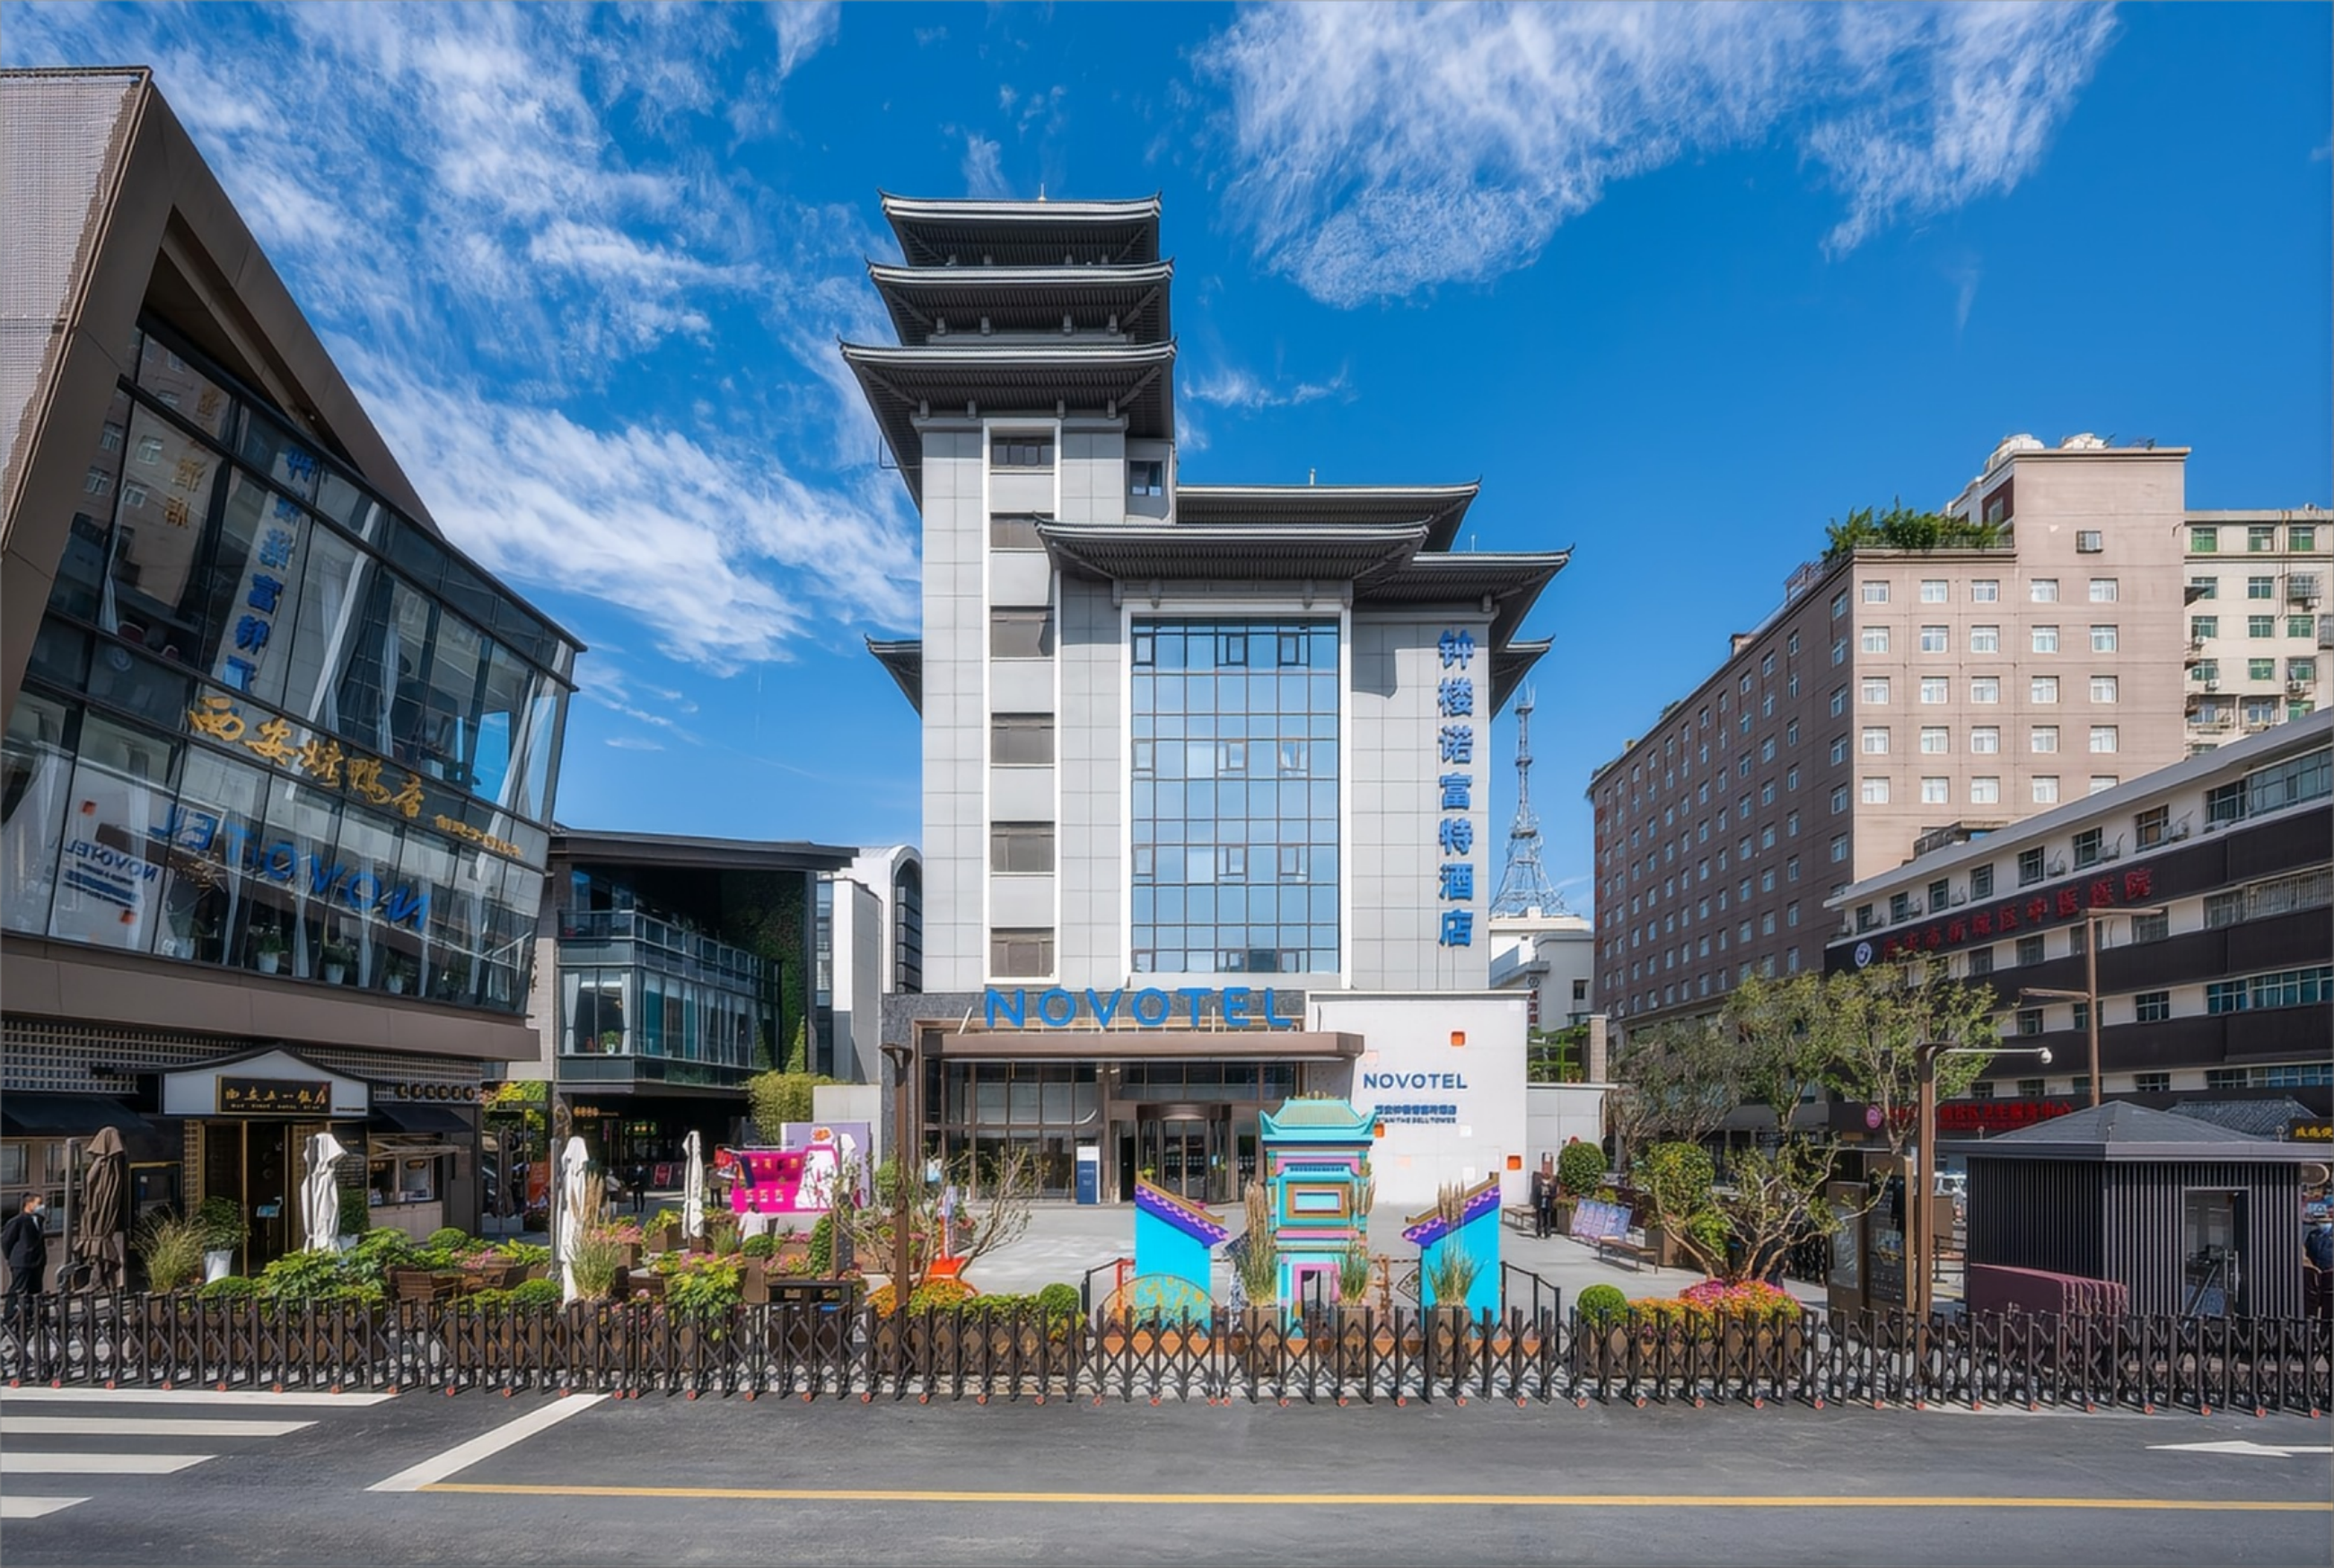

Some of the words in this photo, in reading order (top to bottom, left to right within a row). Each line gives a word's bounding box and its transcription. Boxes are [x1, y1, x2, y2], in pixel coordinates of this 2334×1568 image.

[189, 696, 426, 819] 西安烤鸭店
[1438, 630, 1474, 947] 钟楼诺富特酒店
[985, 987, 1294, 1029] NOVOTEL
[1363, 1073, 1468, 1090] NOVOTEL
